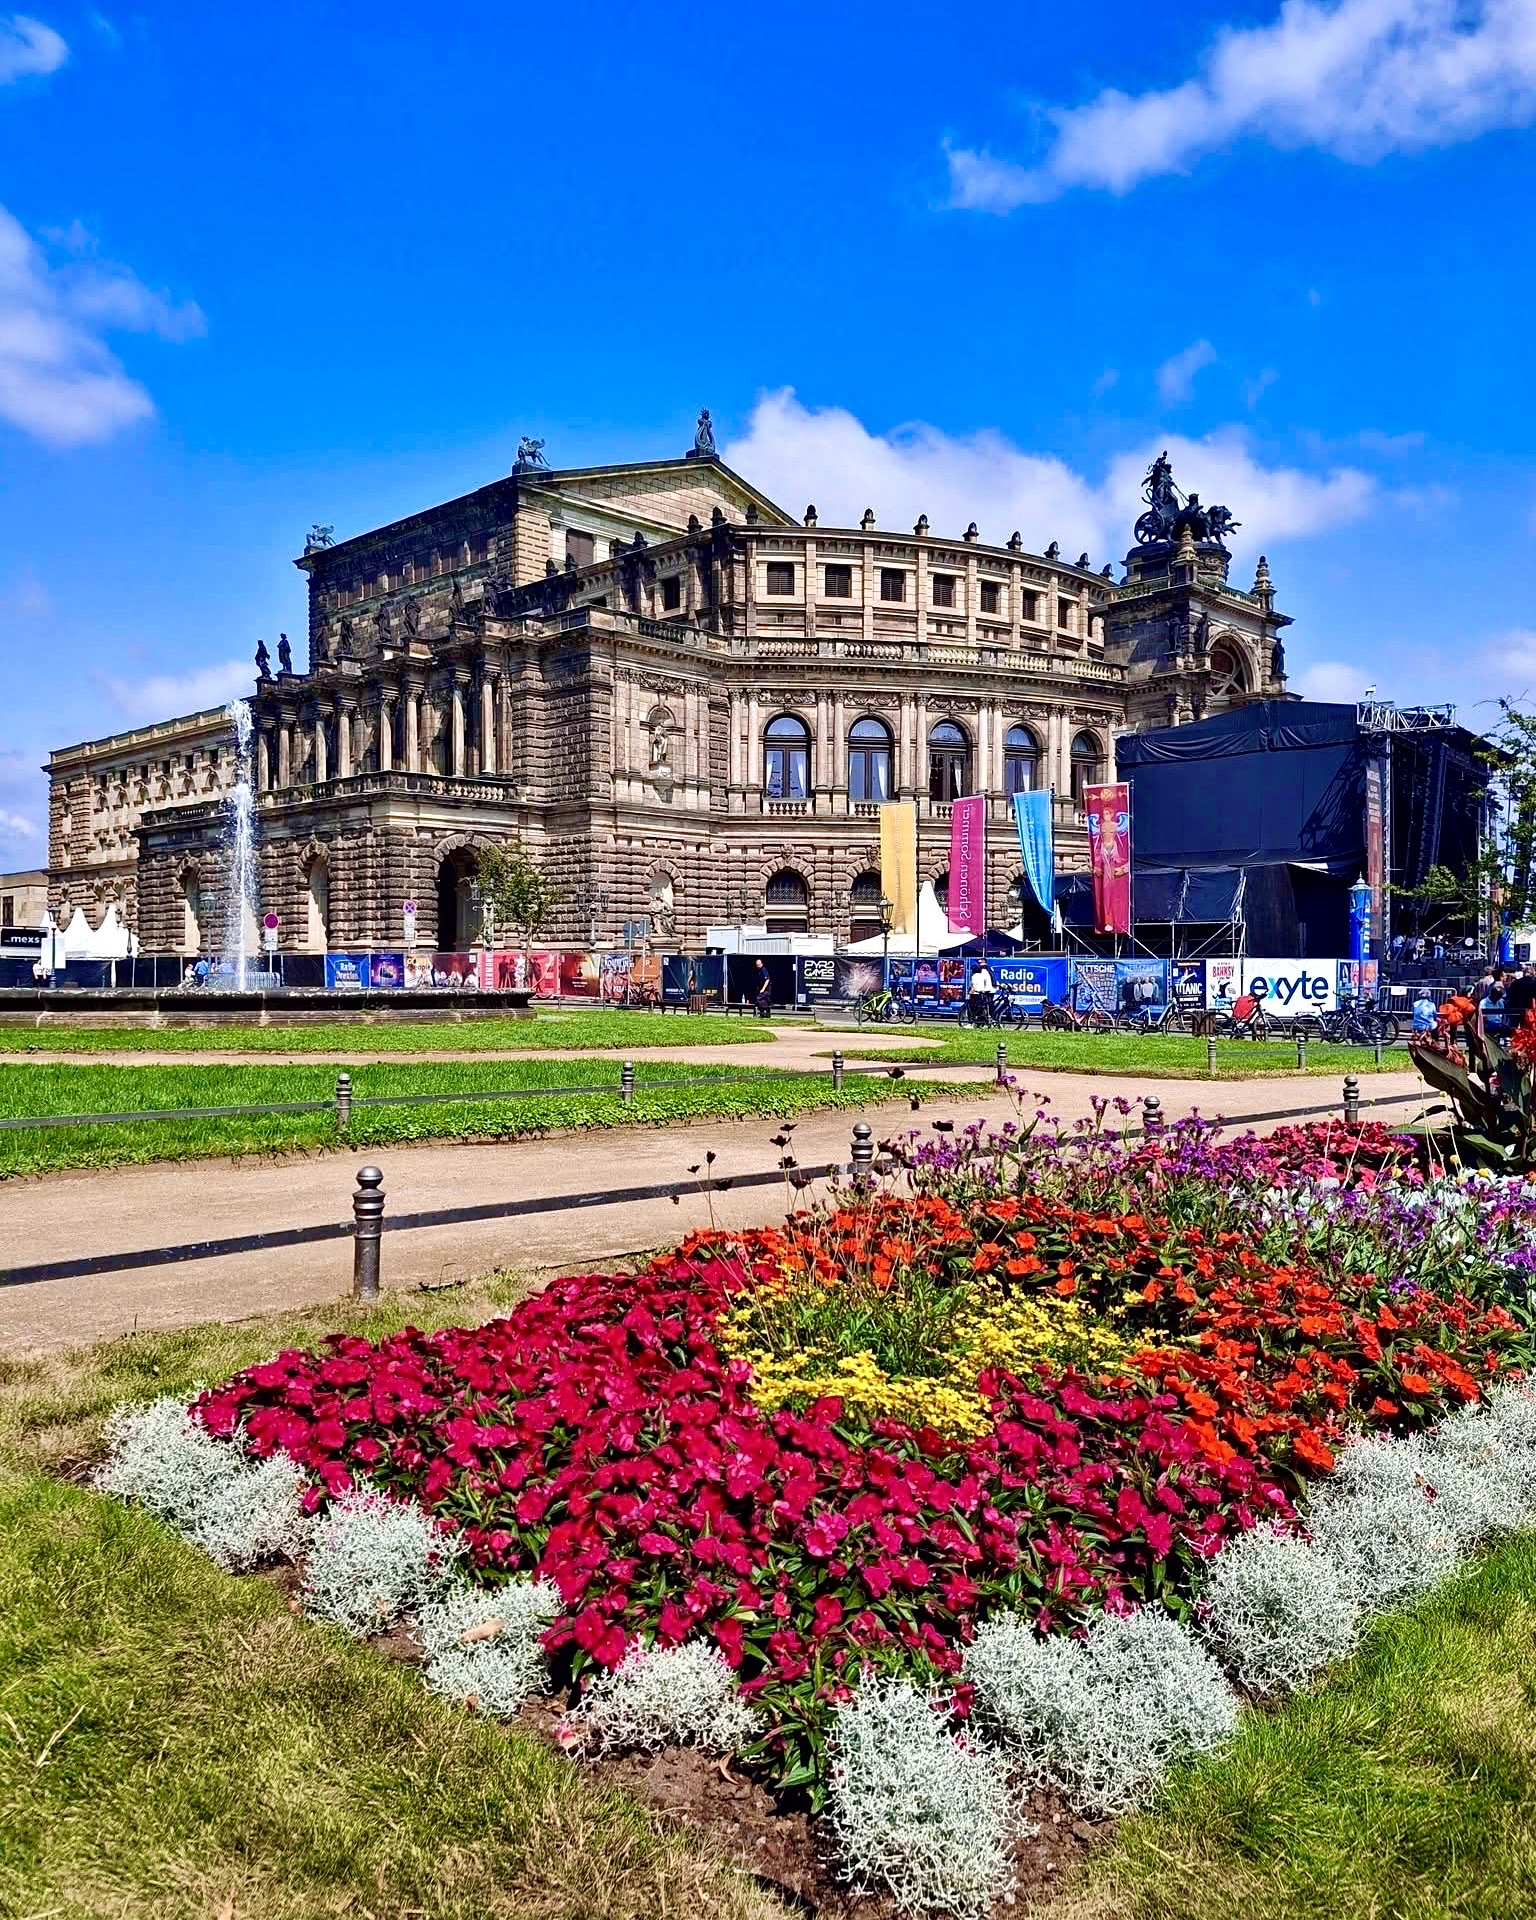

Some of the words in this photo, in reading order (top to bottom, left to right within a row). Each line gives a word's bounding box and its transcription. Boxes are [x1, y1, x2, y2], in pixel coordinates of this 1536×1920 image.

[804, 960, 835, 969] PYRO
[803, 968, 835, 977] GAMES
[1000, 968, 1034, 981] Radio
[1212, 966, 1235, 977] BANKSY
[1174, 982, 1203, 995] TITANIC
[1249, 970, 1329, 1005] exyte
